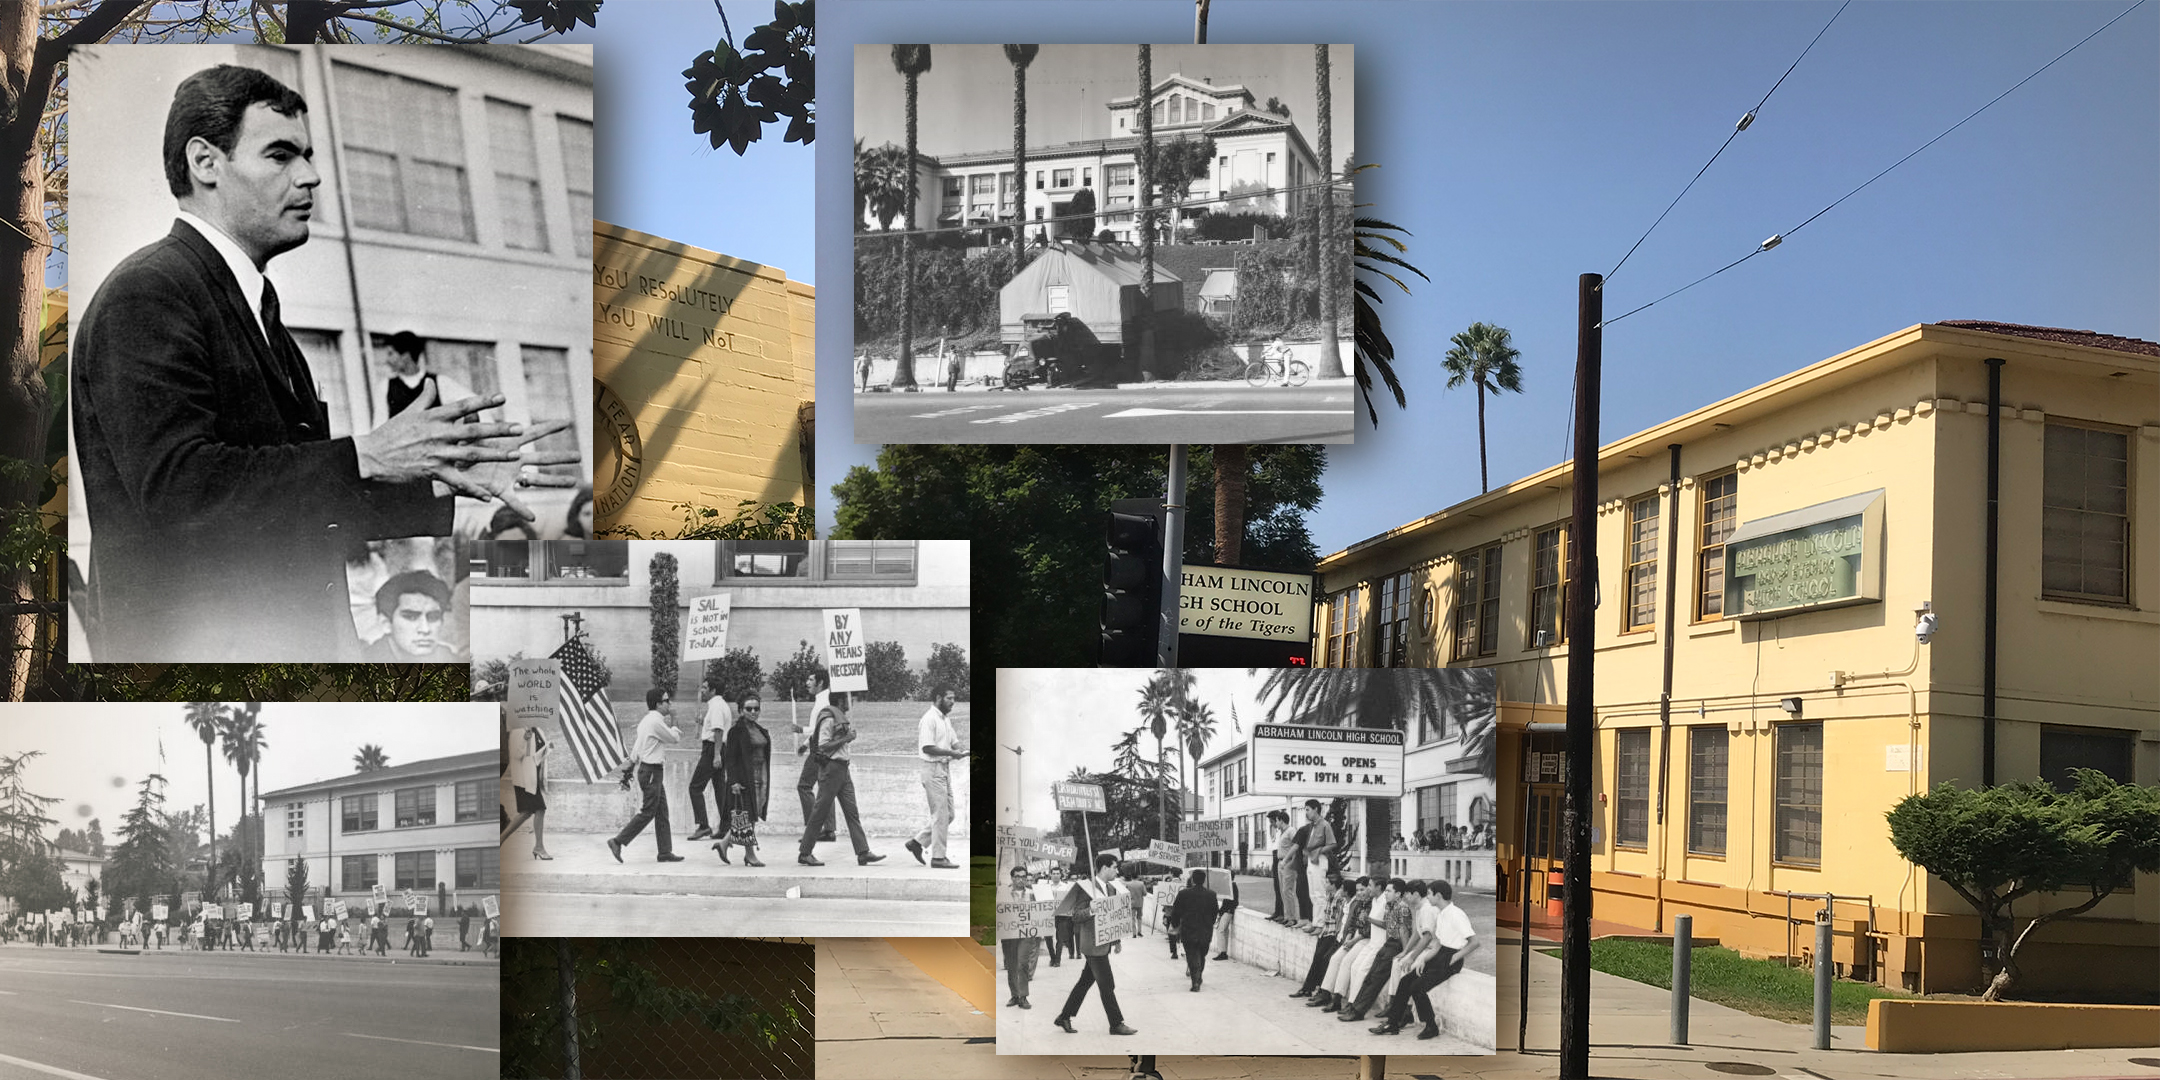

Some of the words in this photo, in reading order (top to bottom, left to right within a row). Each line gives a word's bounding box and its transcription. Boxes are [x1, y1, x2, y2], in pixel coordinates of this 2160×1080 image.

[647, 313, 690, 341] WILL
[607, 400, 636, 445] FEAR
[1231, 577, 1310, 596] LINCOLN
[1787, 576, 1837, 603] SCHOOL
[697, 599, 719, 612] SAL
[1210, 598, 1283, 616] SCHOOL
[702, 613, 719, 623] NOT
[834, 614, 849, 630] BY
[1196, 616, 1214, 632] of
[1219, 618, 1243, 631] the
[1250, 620, 1296, 636] Tigers
[829, 630, 852, 646] ANY
[835, 645, 863, 659] MEANS
[512, 667, 529, 676] The
[532, 665, 556, 675] whole
[517, 680, 552, 689] WORLD
[514, 704, 554, 715] watching
[1257, 726, 1305, 739] ABRAHAM
[1308, 731, 1343, 741] LINCOLN
[1346, 733, 1366, 743] HIGH
[1369, 733, 1401, 744] SCHOOL
[1283, 754, 1326, 767] SCHOOL
[1342, 757, 1377, 768] OPENS
[1274, 770, 1306, 782] SEPT.
[1315, 772, 1339, 783] 19TH
[1346, 773, 1353, 783] 8
[1362, 774, 1386, 785] A.M.
[1181, 820, 1219, 833] CHICANOS
[1041, 843, 1073, 857] POWER
[1181, 837, 1228, 849] EDUCATION
[997, 902, 1053, 914] GRADUATES
[1019, 927, 1038, 938] NO
